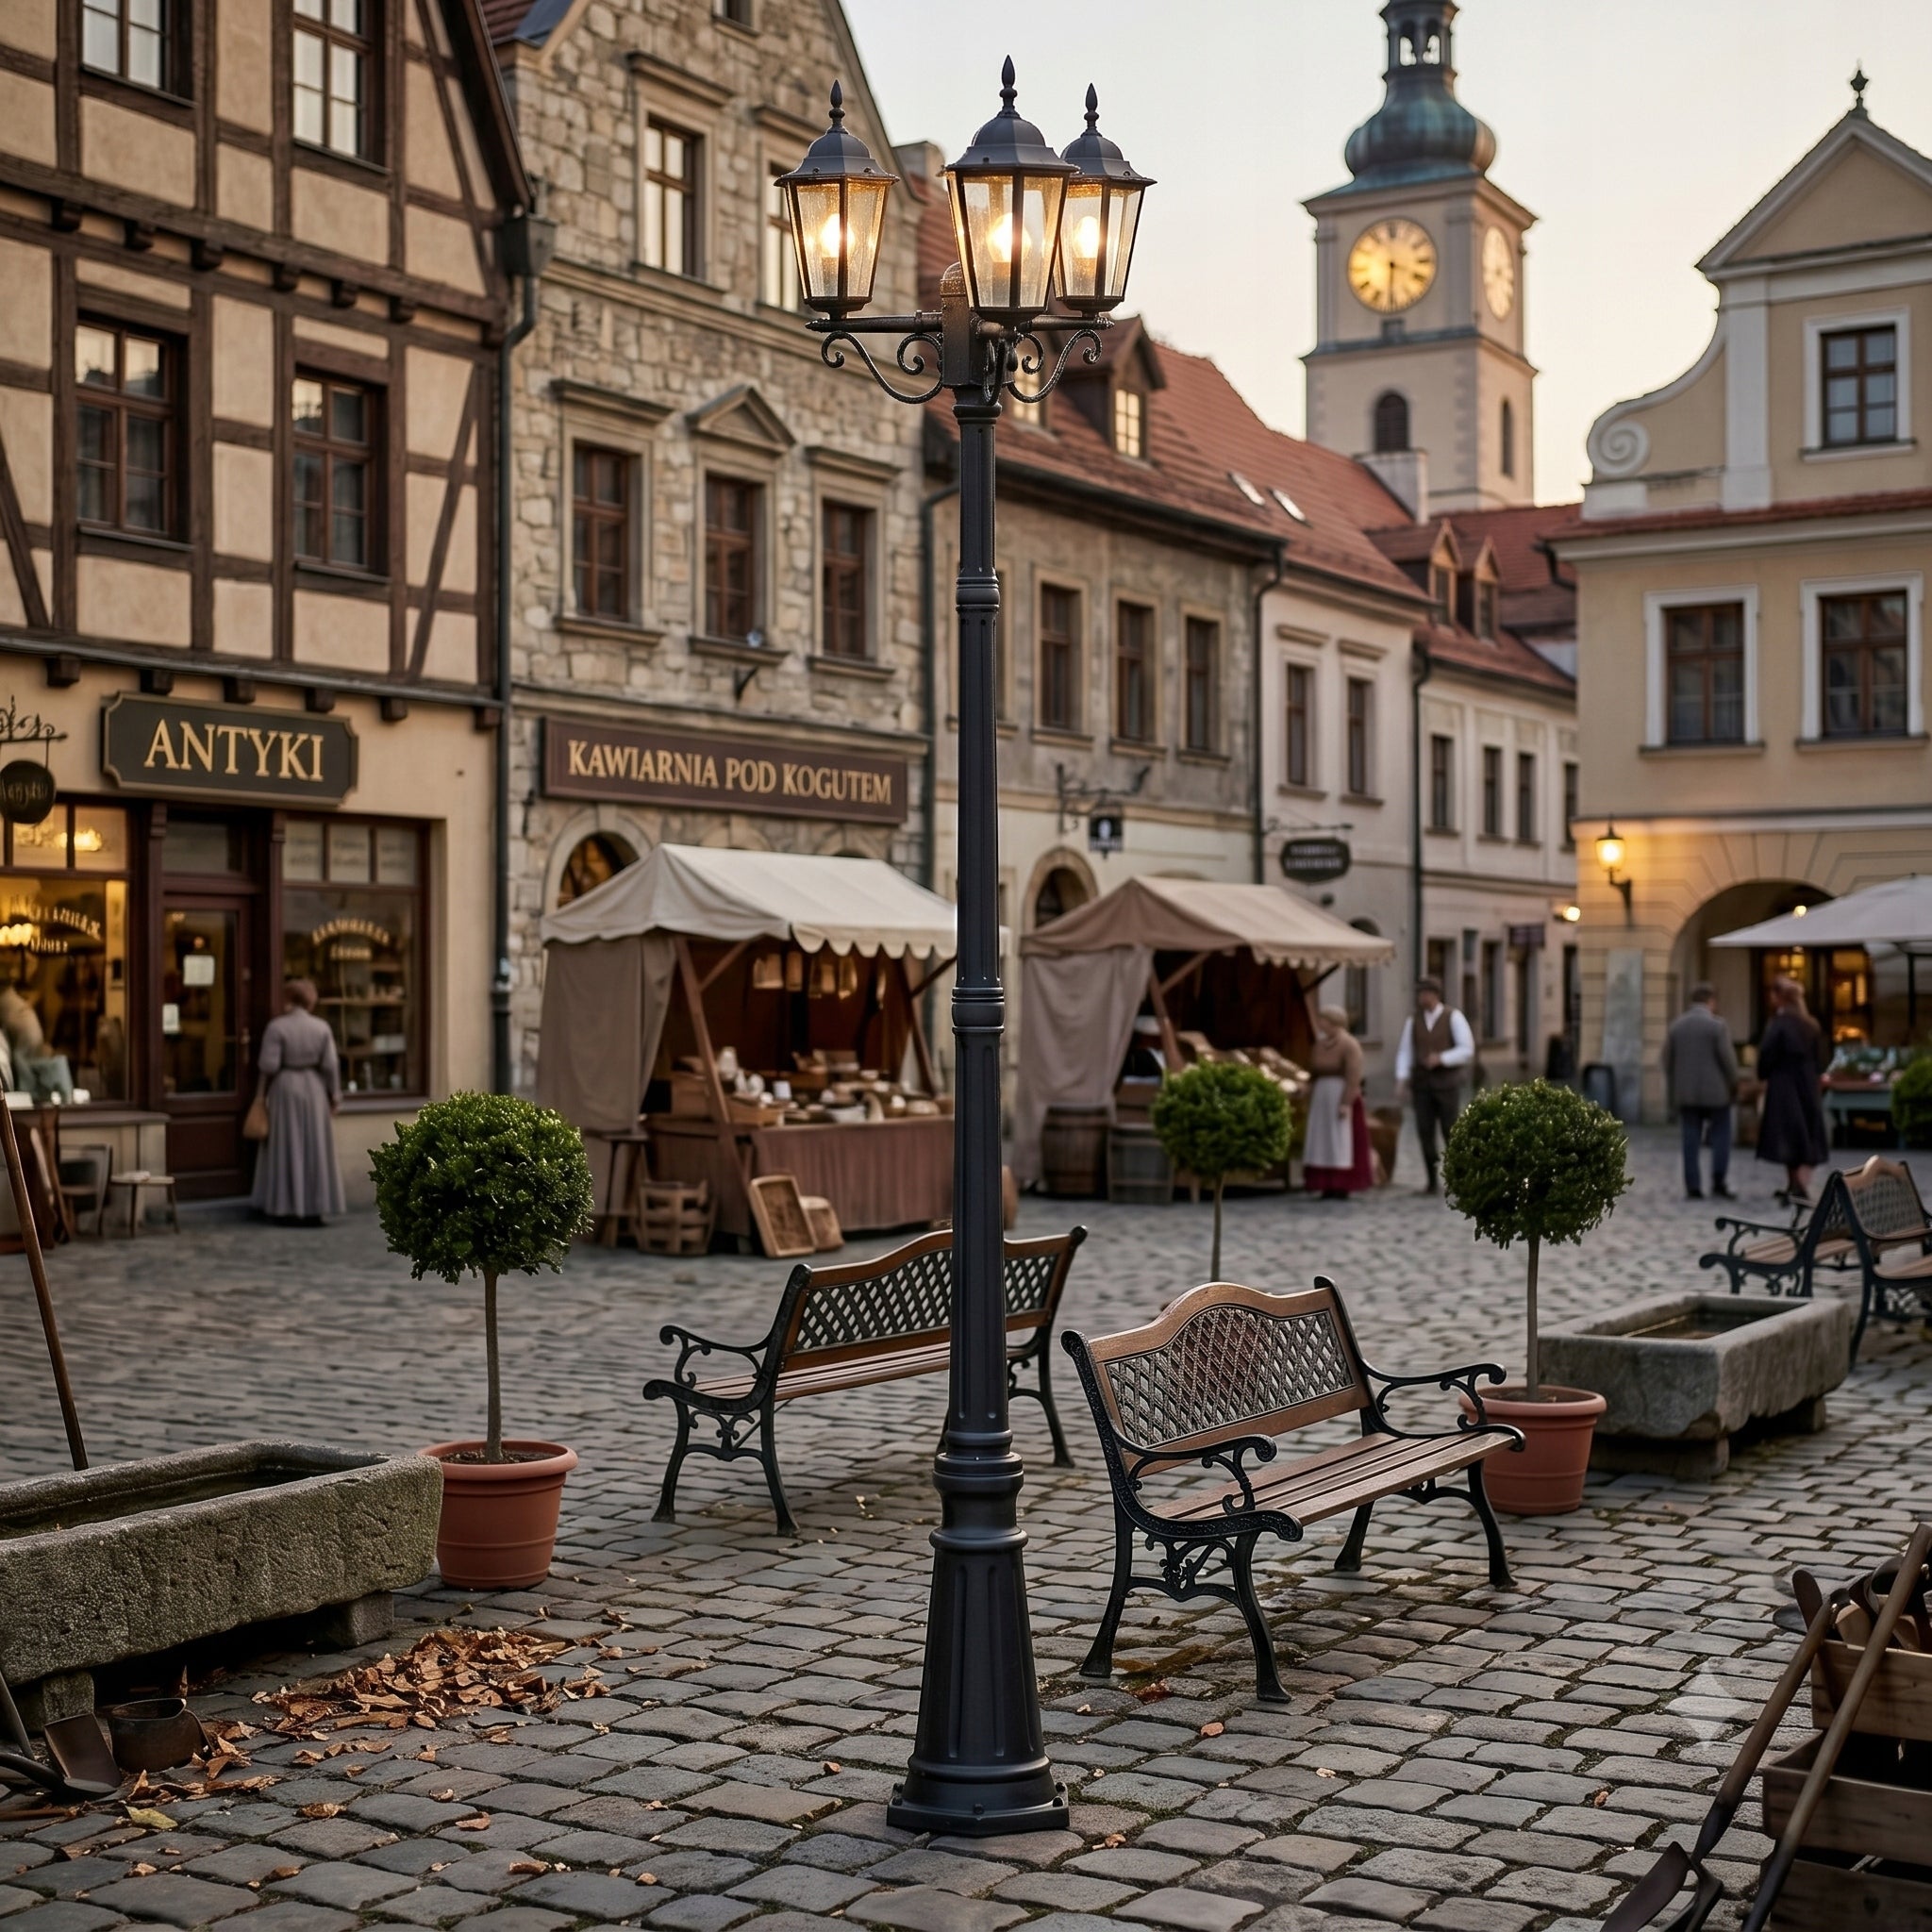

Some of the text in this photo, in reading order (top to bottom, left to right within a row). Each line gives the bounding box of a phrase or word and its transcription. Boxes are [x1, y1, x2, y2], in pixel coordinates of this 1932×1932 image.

[144, 719, 324, 781] ANTYKI
[568, 739, 892, 805] KAWIARNIA POD KOGUTEM
